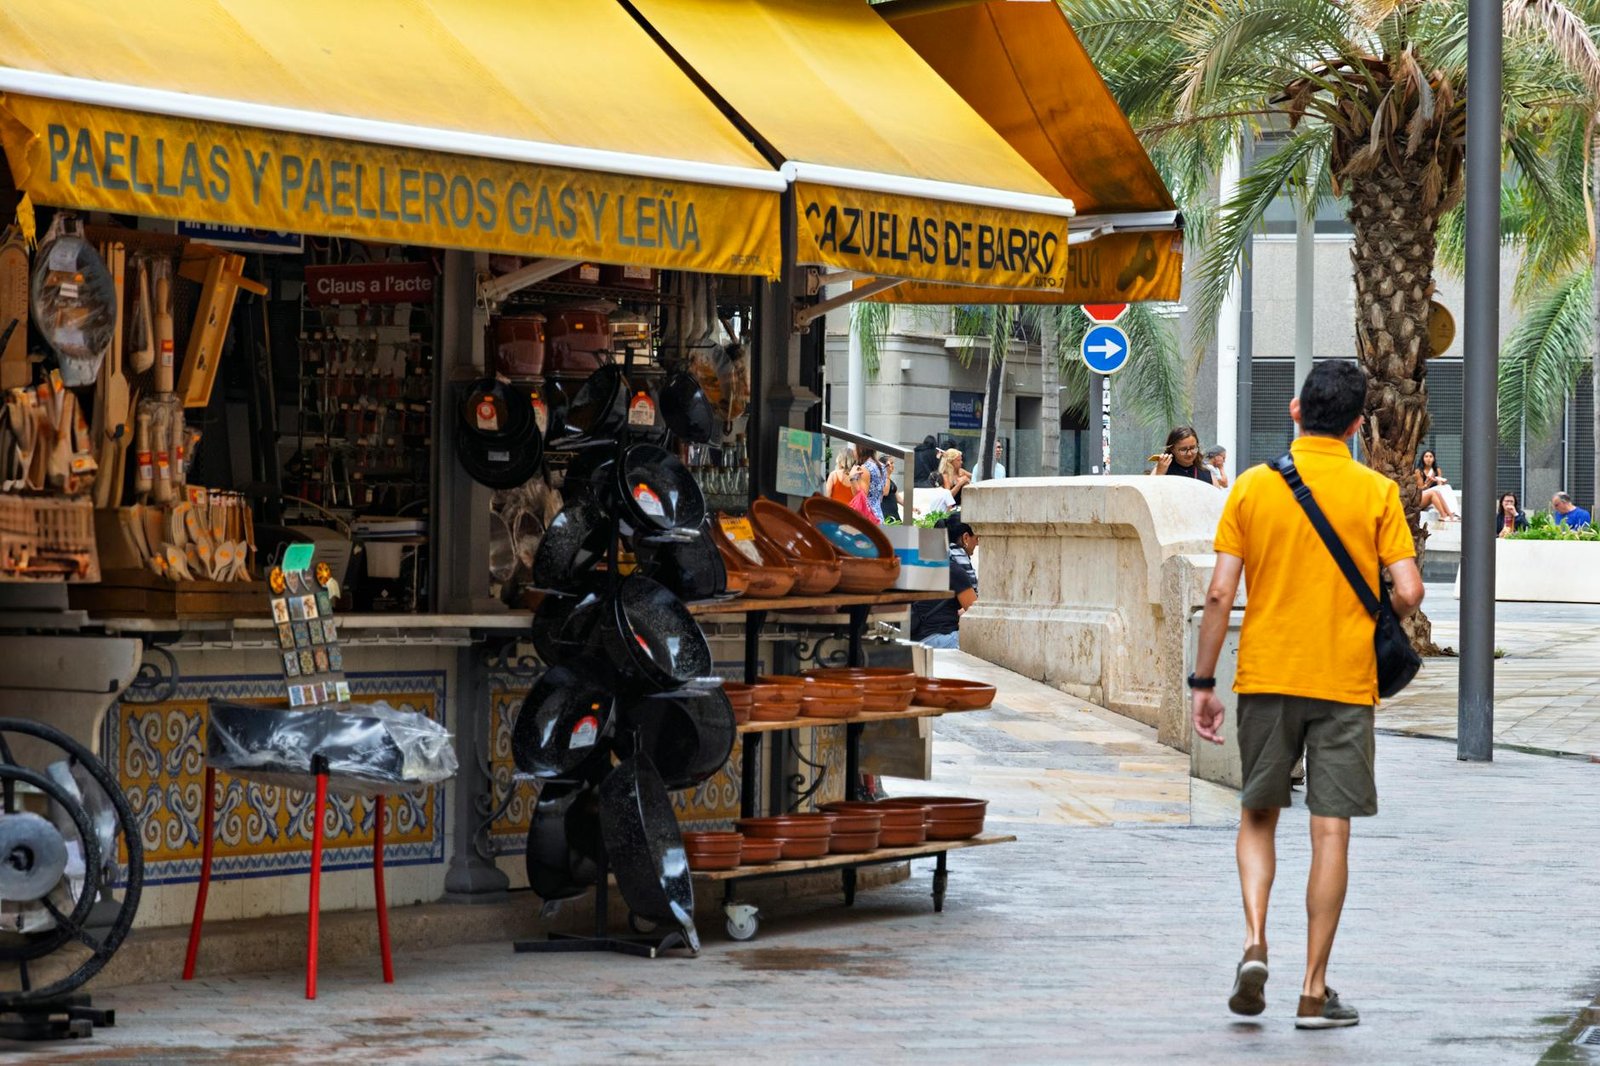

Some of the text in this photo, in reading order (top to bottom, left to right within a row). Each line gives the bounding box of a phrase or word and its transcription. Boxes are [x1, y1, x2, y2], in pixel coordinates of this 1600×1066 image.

[47, 123, 701, 252] PAELLAS Y PAELLEROS GAS Y LEÑA
[805, 202, 1059, 274] CAZUELAS DE BARRO
[317, 274, 432, 295] Claus a l'acte
